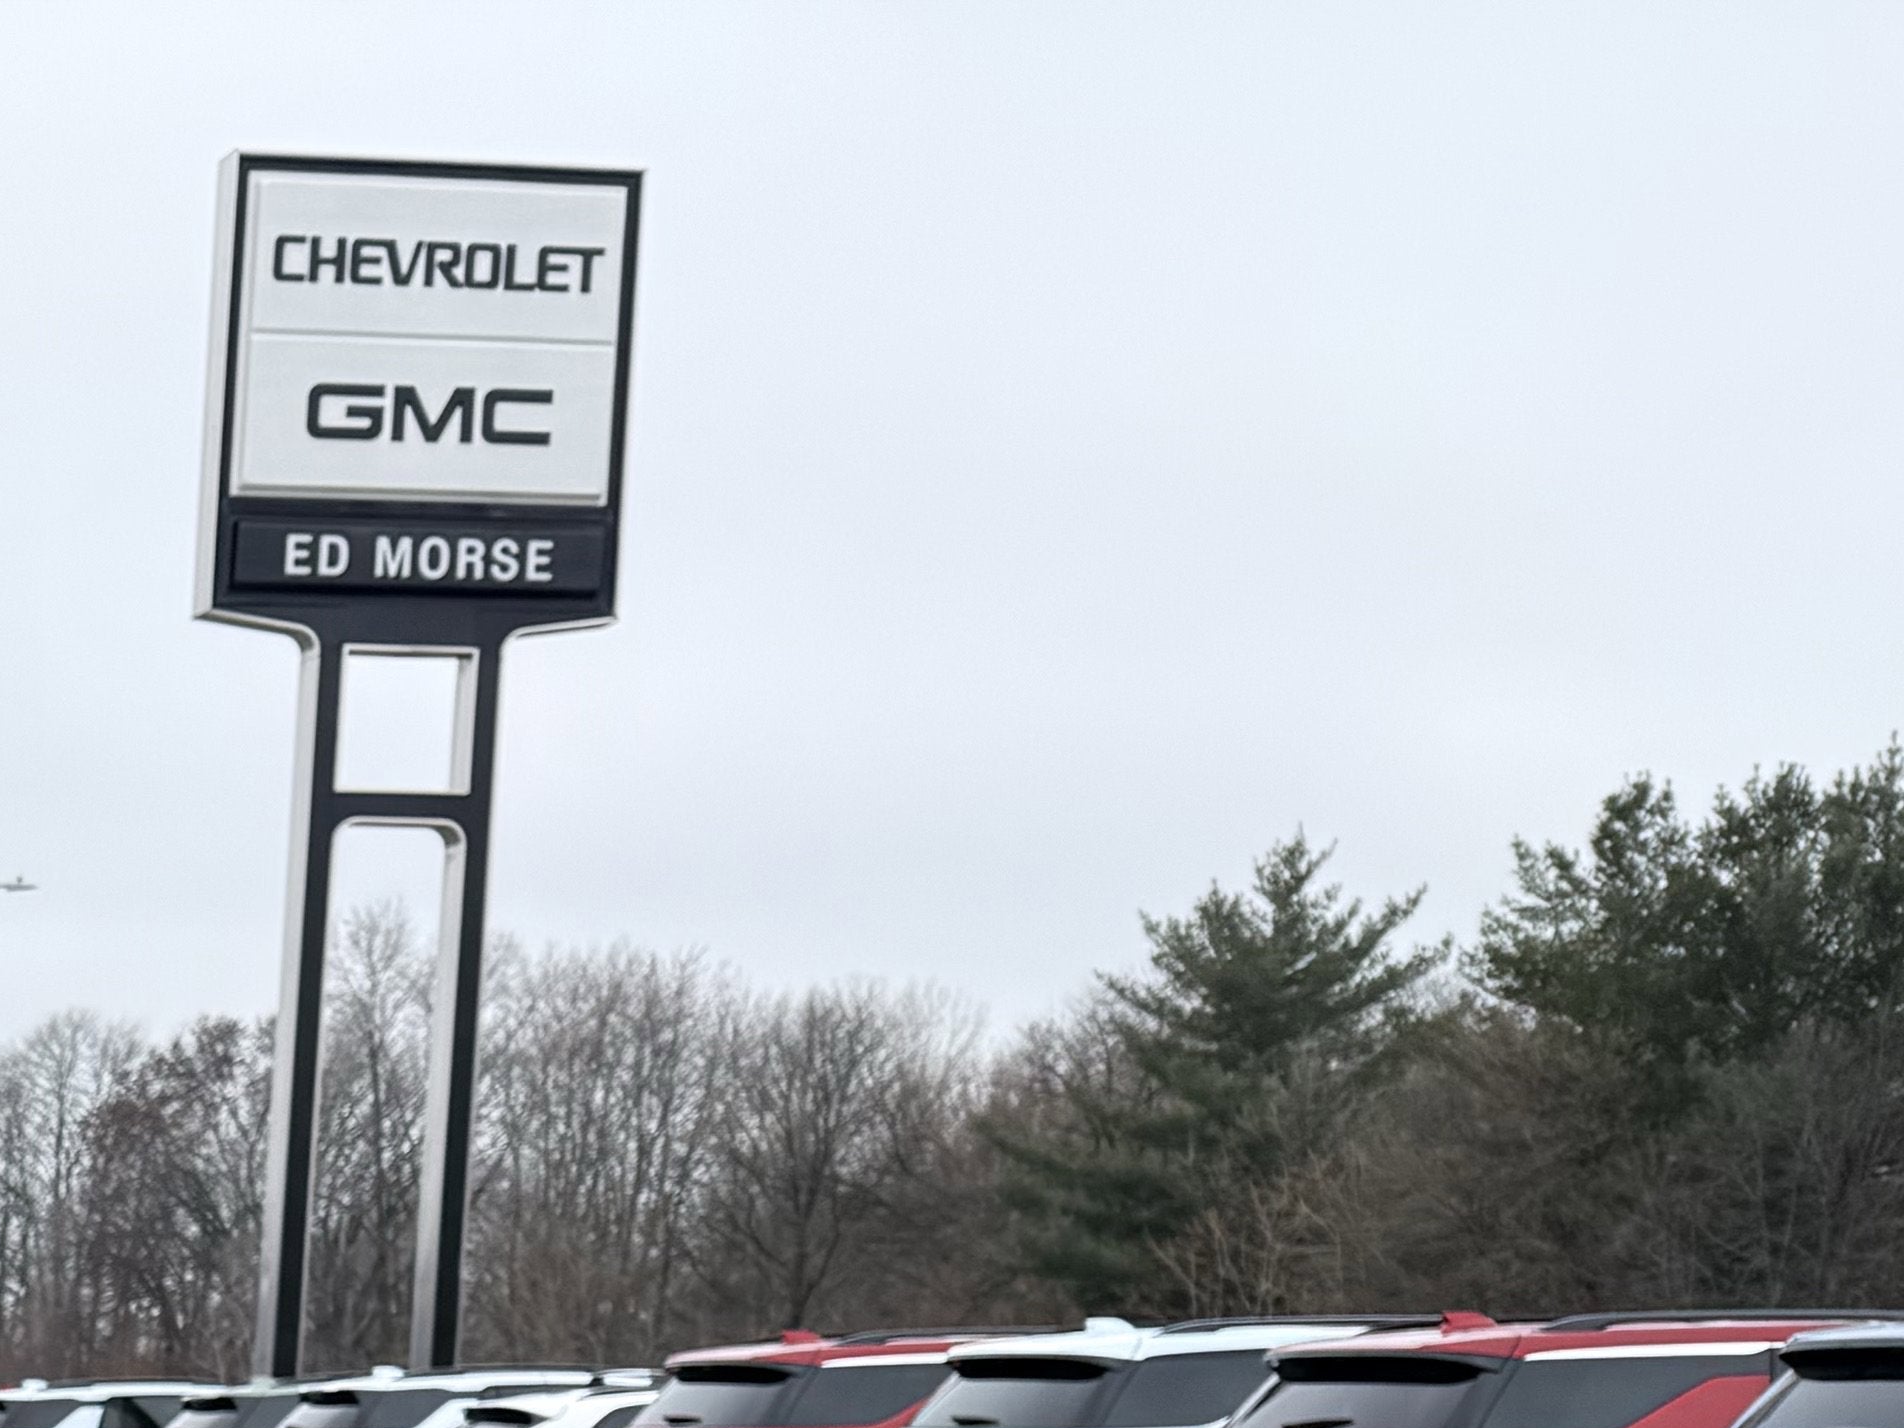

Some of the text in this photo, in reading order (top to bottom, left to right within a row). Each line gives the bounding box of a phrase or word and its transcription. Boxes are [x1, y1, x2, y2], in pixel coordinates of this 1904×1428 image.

[272, 234, 606, 294] CHEVROLET
[306, 382, 554, 446] GMC
[283, 532, 555, 582] ED MORSE
